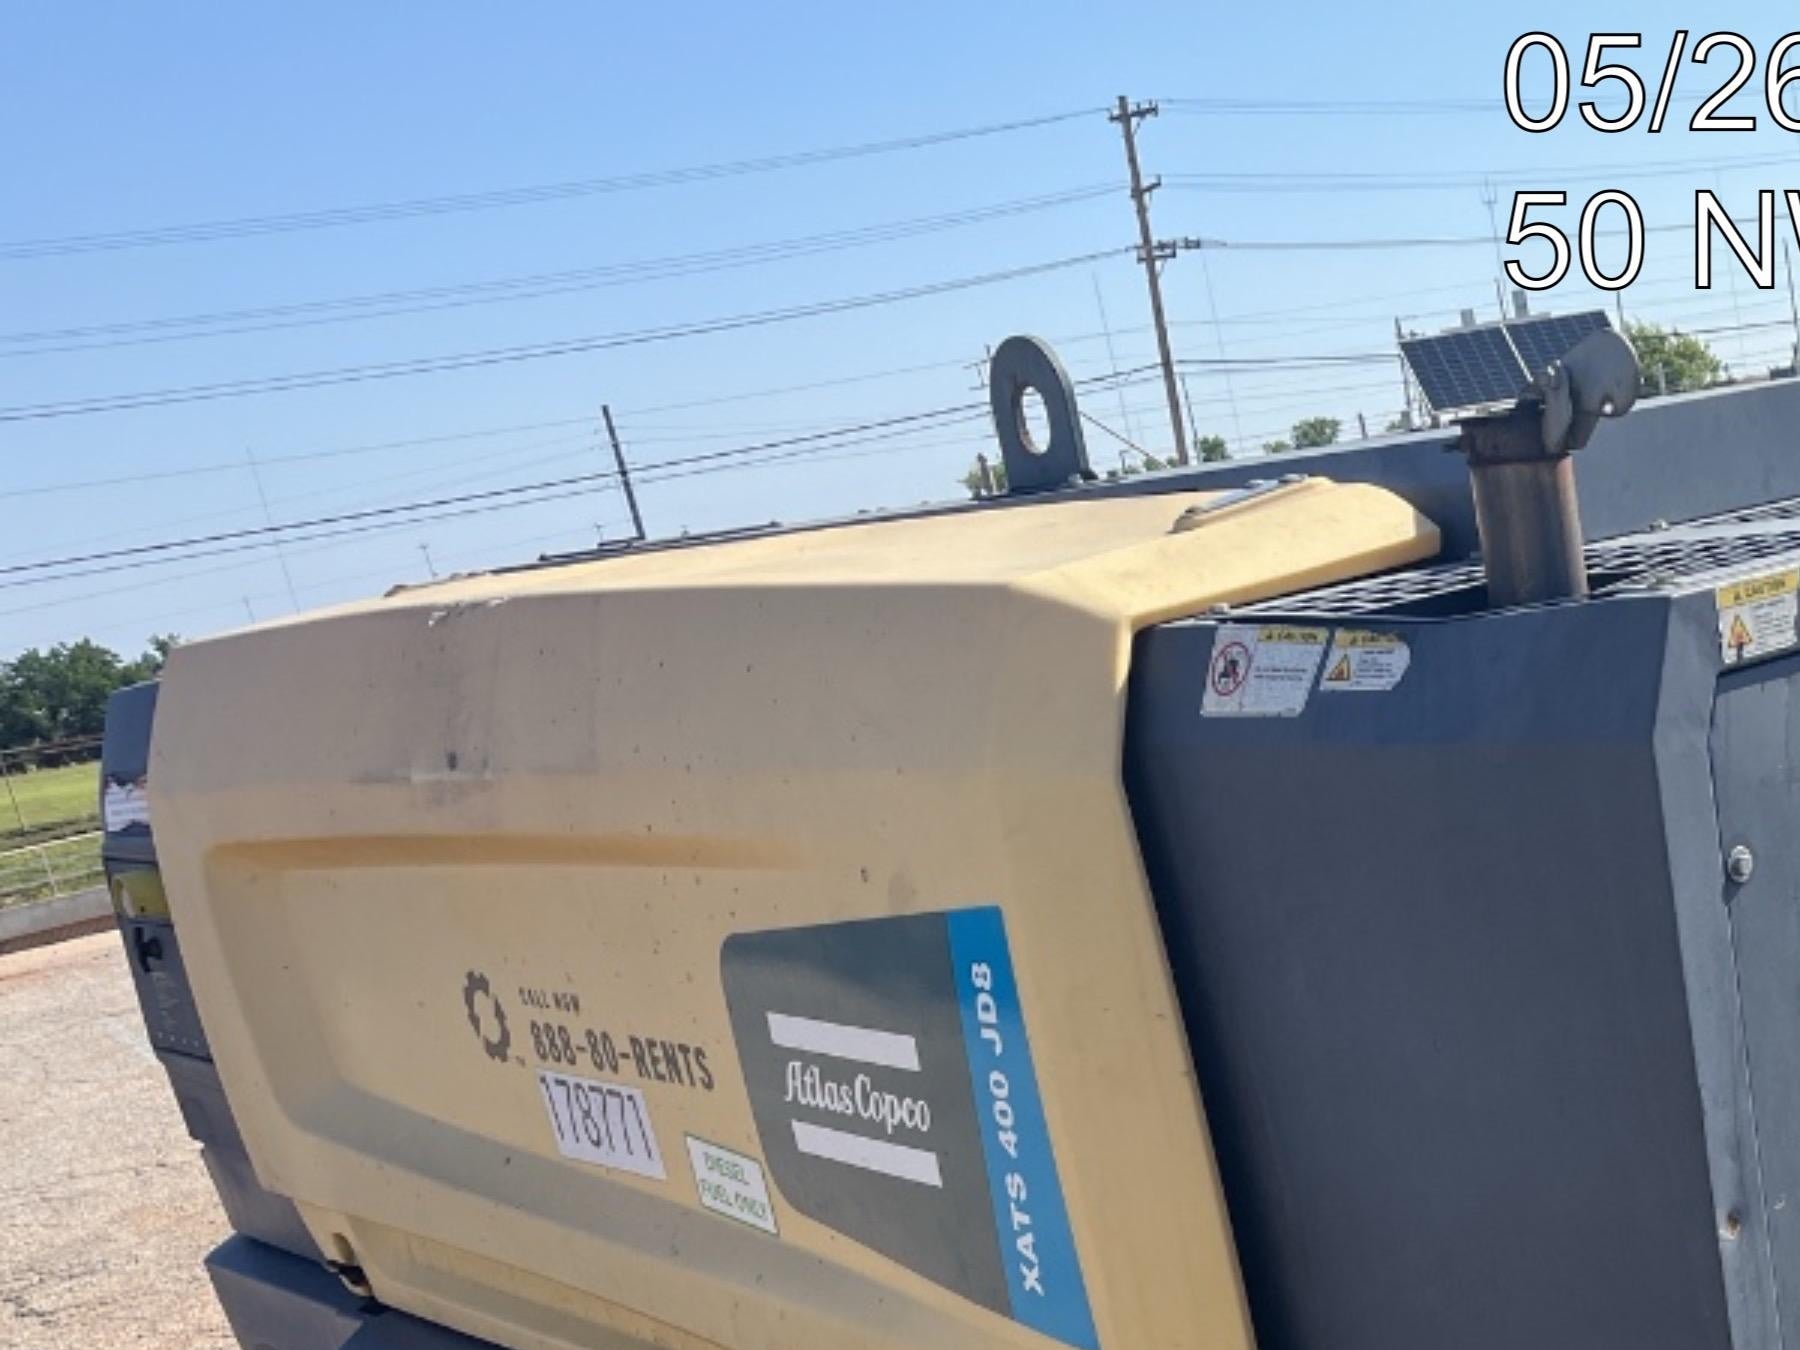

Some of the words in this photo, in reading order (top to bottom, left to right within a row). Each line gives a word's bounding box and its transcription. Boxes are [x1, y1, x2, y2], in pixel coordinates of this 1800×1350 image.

[971, 961, 1003, 1058] JD8
[530, 1019, 715, 1092] 888-80-RENTS
[784, 1061, 853, 1117] Atlas
[854, 1073, 931, 1135] Copco
[540, 1075, 654, 1161] 178771
[989, 1069, 1019, 1160] 400
[1005, 1171, 1045, 1298] XATS
